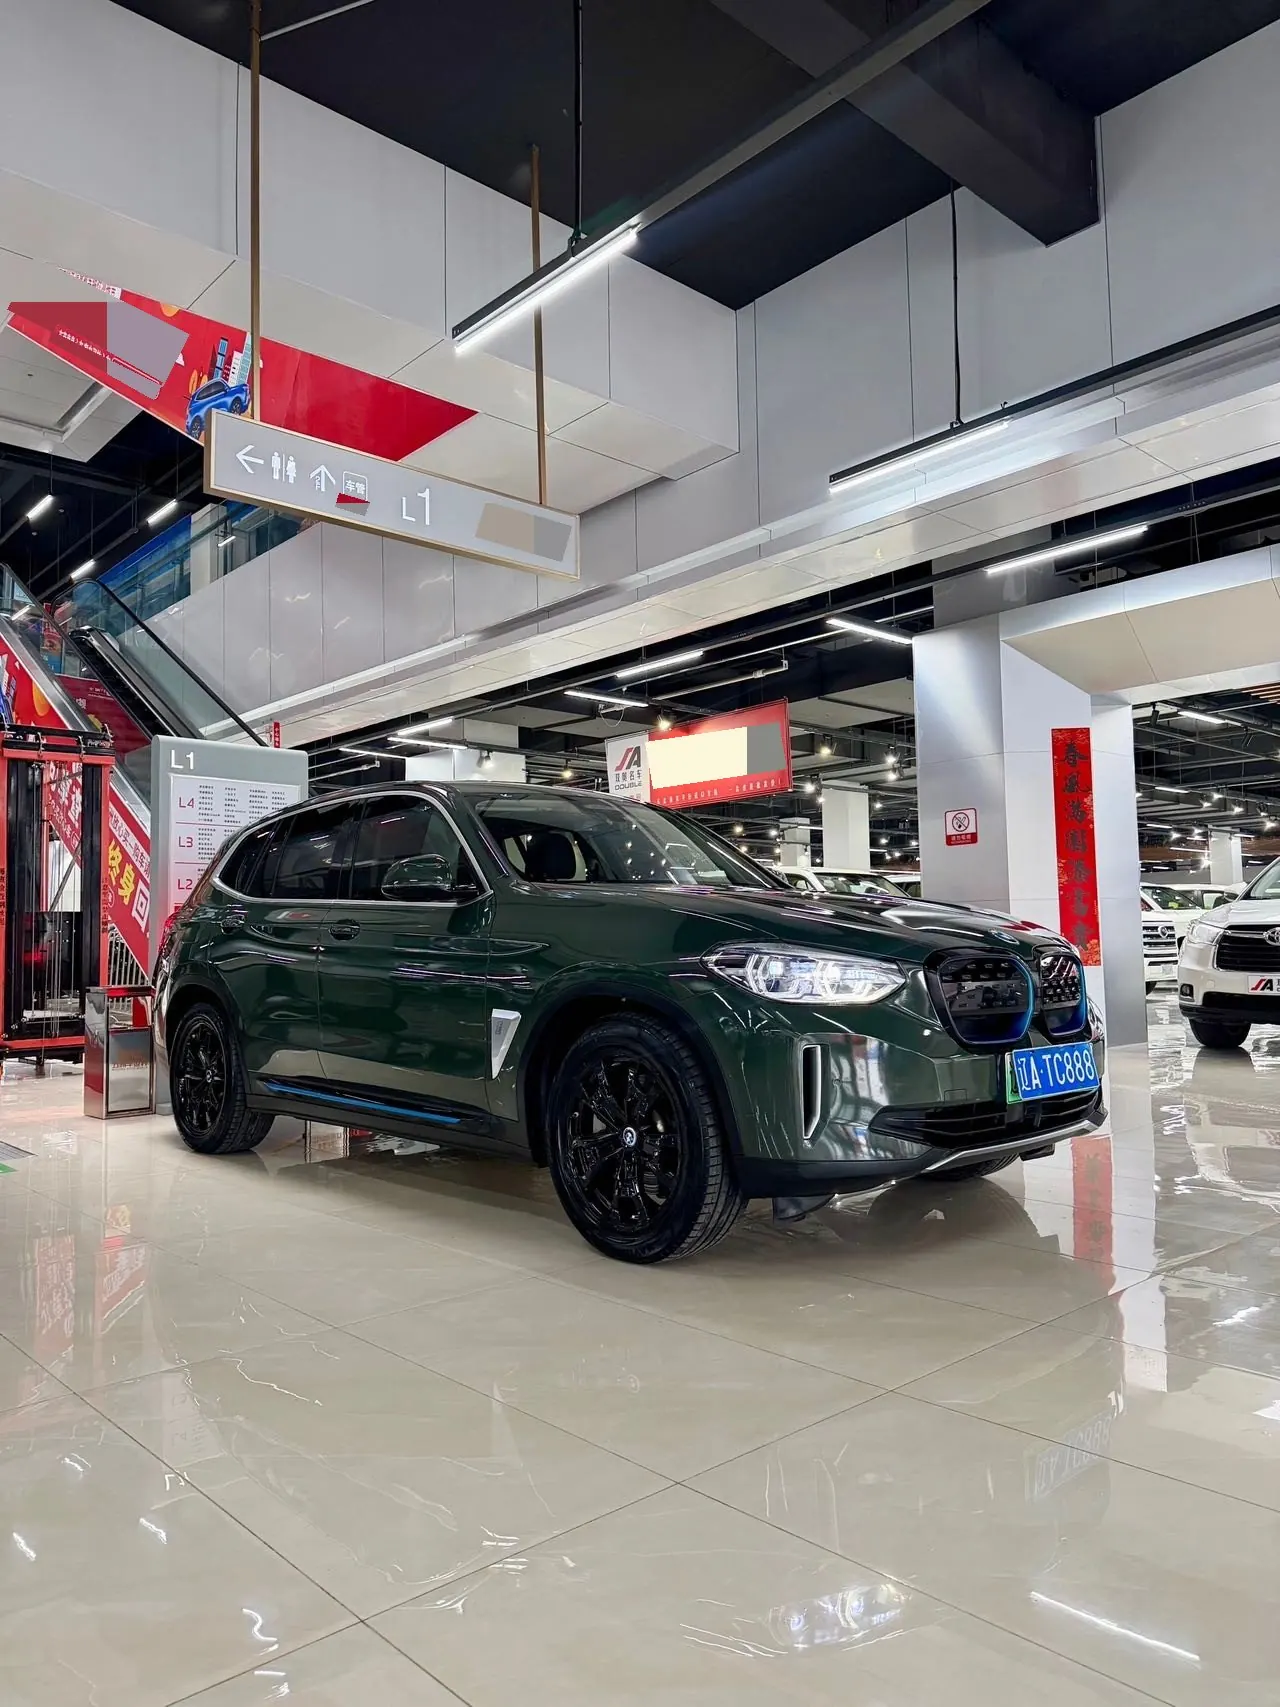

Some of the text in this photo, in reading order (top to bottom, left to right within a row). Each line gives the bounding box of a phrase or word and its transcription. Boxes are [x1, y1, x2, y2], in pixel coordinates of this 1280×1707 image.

[345, 480, 366, 495] 车管
[401, 488, 430, 526] L1
[170, 749, 195, 770] L1
[614, 781, 643, 791] DOUBLE
[178, 796, 195, 809] L4
[178, 836, 194, 848] L3
[177, 878, 193, 890] L2
